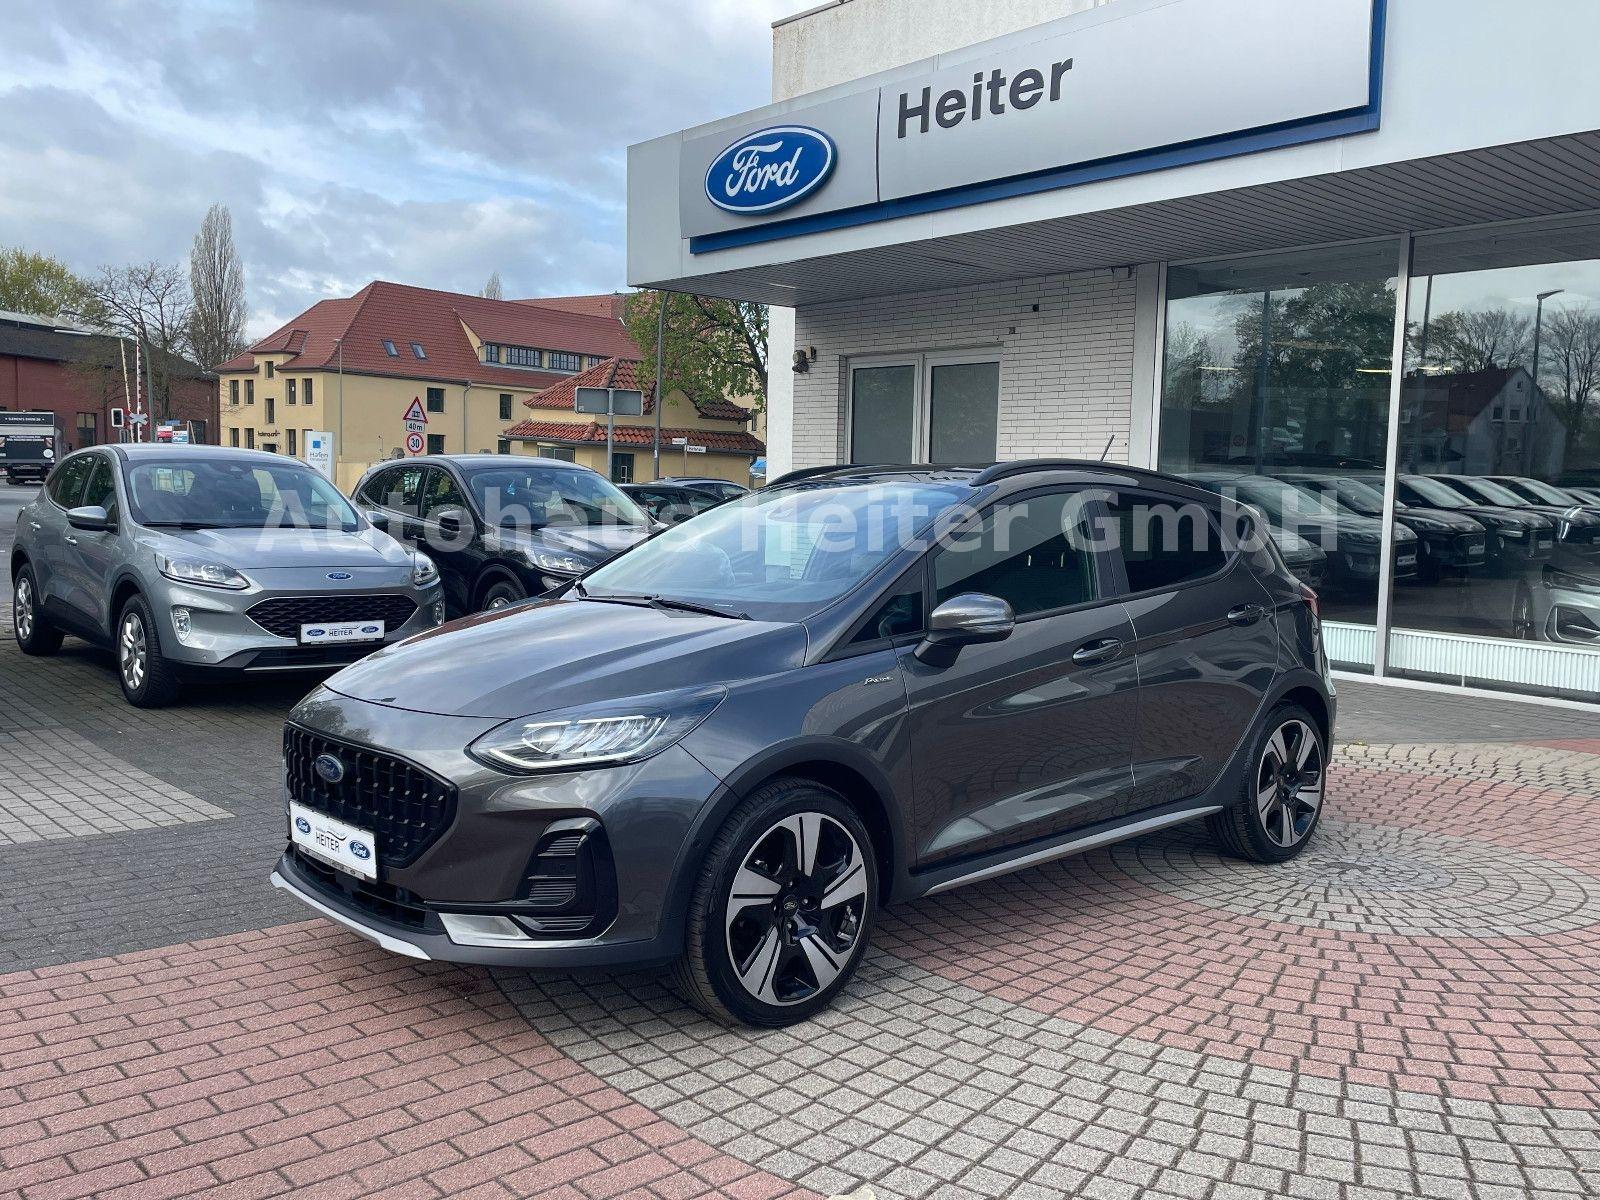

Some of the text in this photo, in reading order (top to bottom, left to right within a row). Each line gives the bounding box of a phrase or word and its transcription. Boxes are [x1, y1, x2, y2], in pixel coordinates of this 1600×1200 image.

[897, 57, 1074, 139] Heiter
[725, 140, 804, 197] Ford
[410, 438, 420, 449] 30
[328, 629, 353, 637] HEITER
[315, 831, 341, 854] HEITER
[351, 841, 369, 859] Ford
